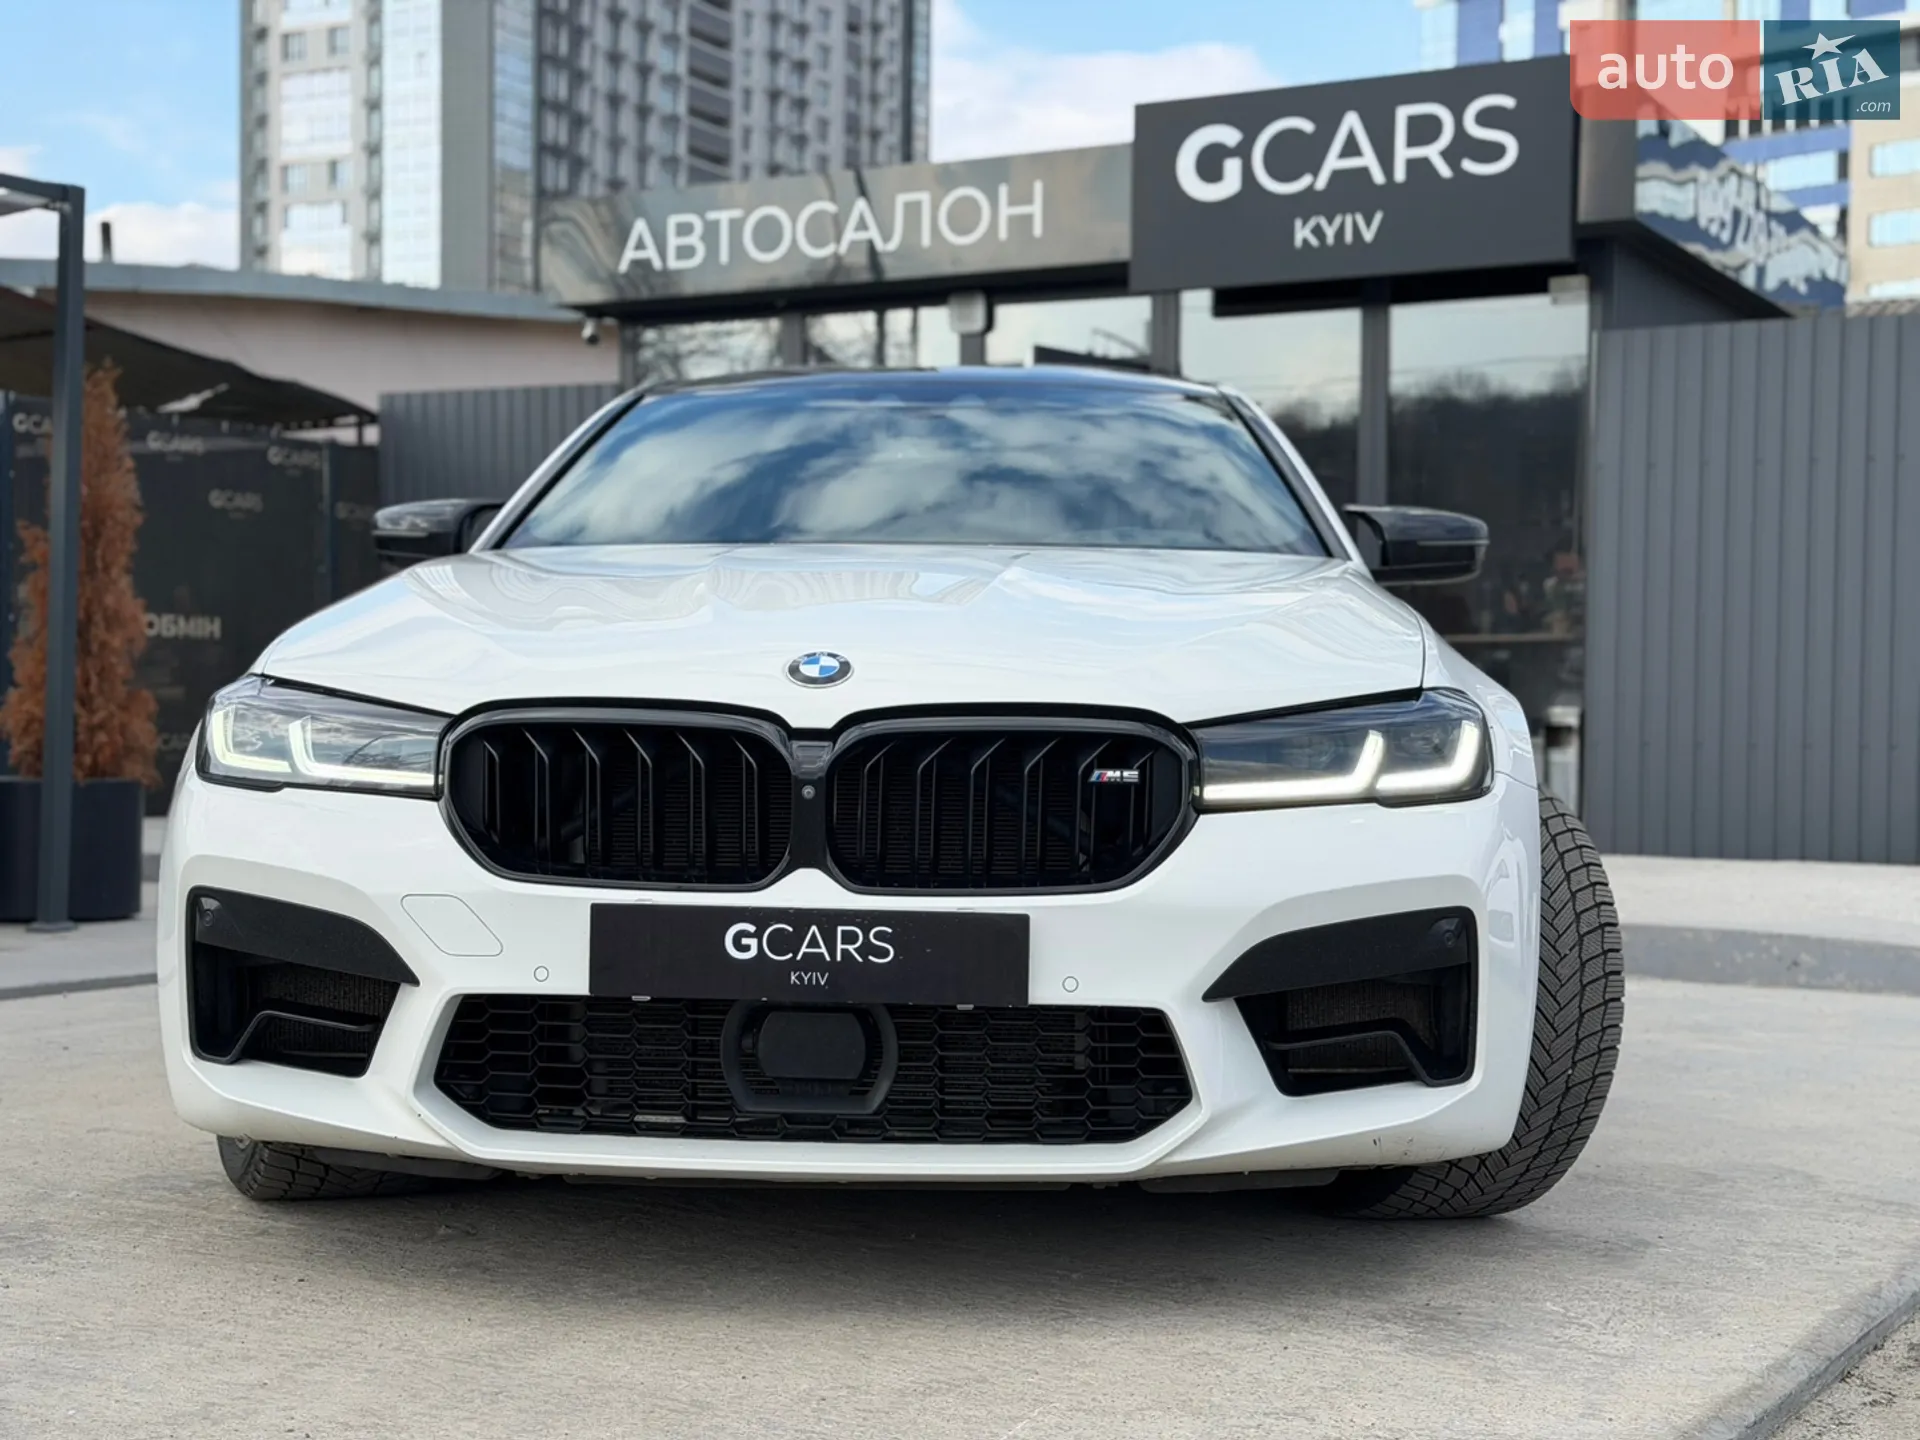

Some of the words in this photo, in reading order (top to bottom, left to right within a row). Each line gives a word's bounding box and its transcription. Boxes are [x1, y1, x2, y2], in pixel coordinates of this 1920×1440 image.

[1175, 93, 1520, 203] GCARS
[617, 179, 1044, 274] АВТОСАЛОН
[1293, 210, 1384, 249] KYIV
[724, 922, 895, 963] GCARS
[790, 971, 829, 985] KYIV
